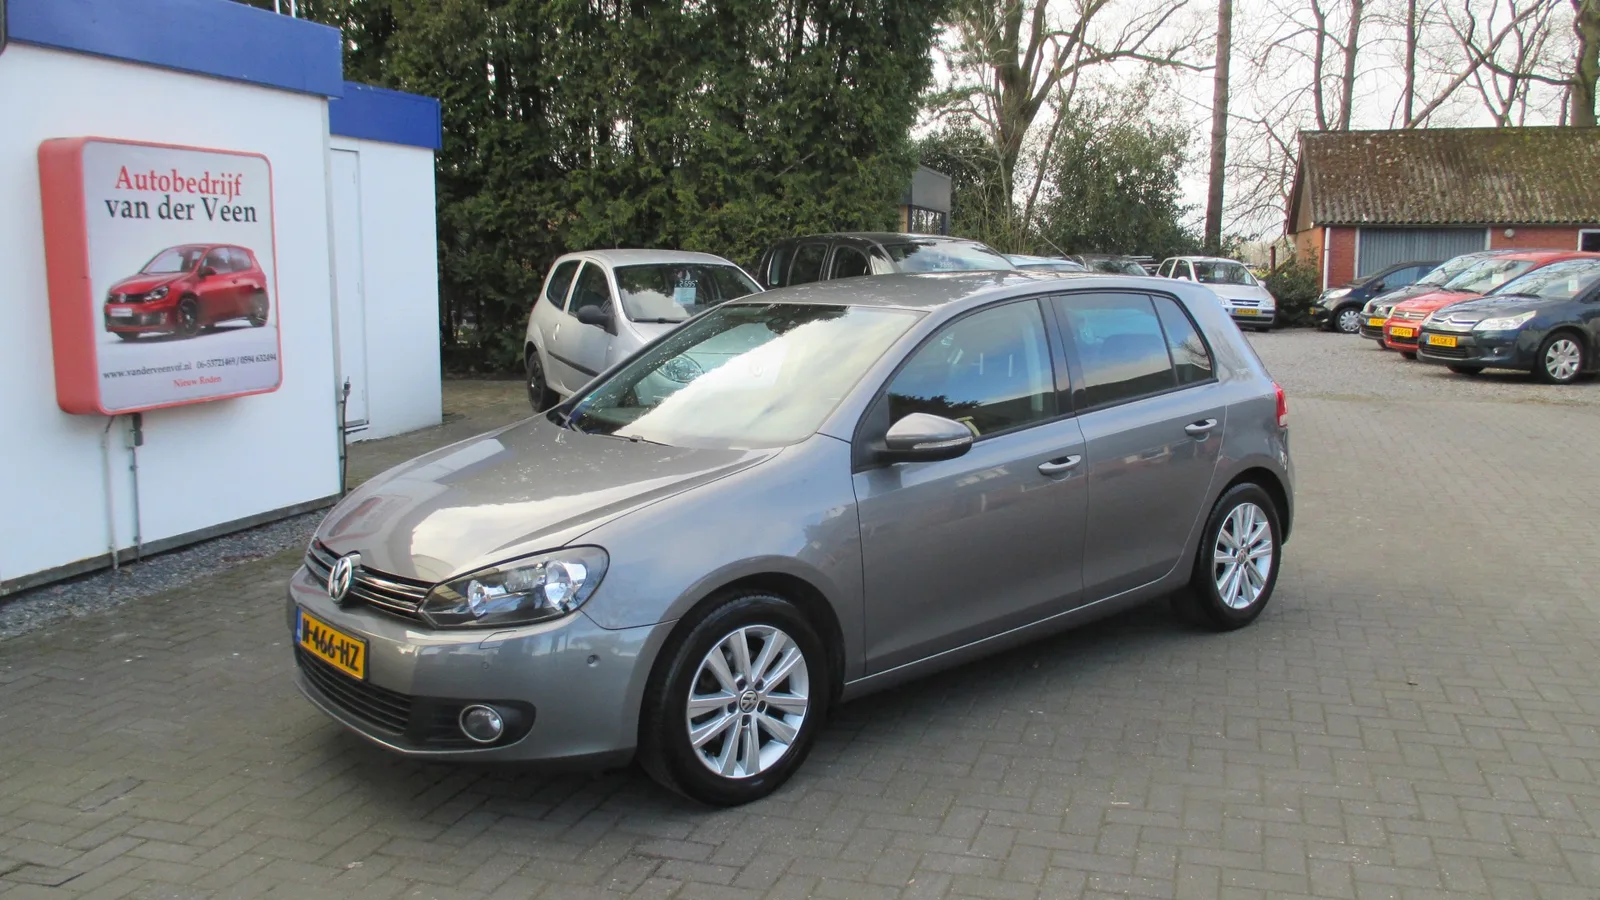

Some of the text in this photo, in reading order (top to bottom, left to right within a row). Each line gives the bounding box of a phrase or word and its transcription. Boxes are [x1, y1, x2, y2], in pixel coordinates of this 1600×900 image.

[115, 165, 243, 203] Autobedrijf
[104, 194, 258, 223] van der Veen
[172, 378, 198, 388] Nieuw
